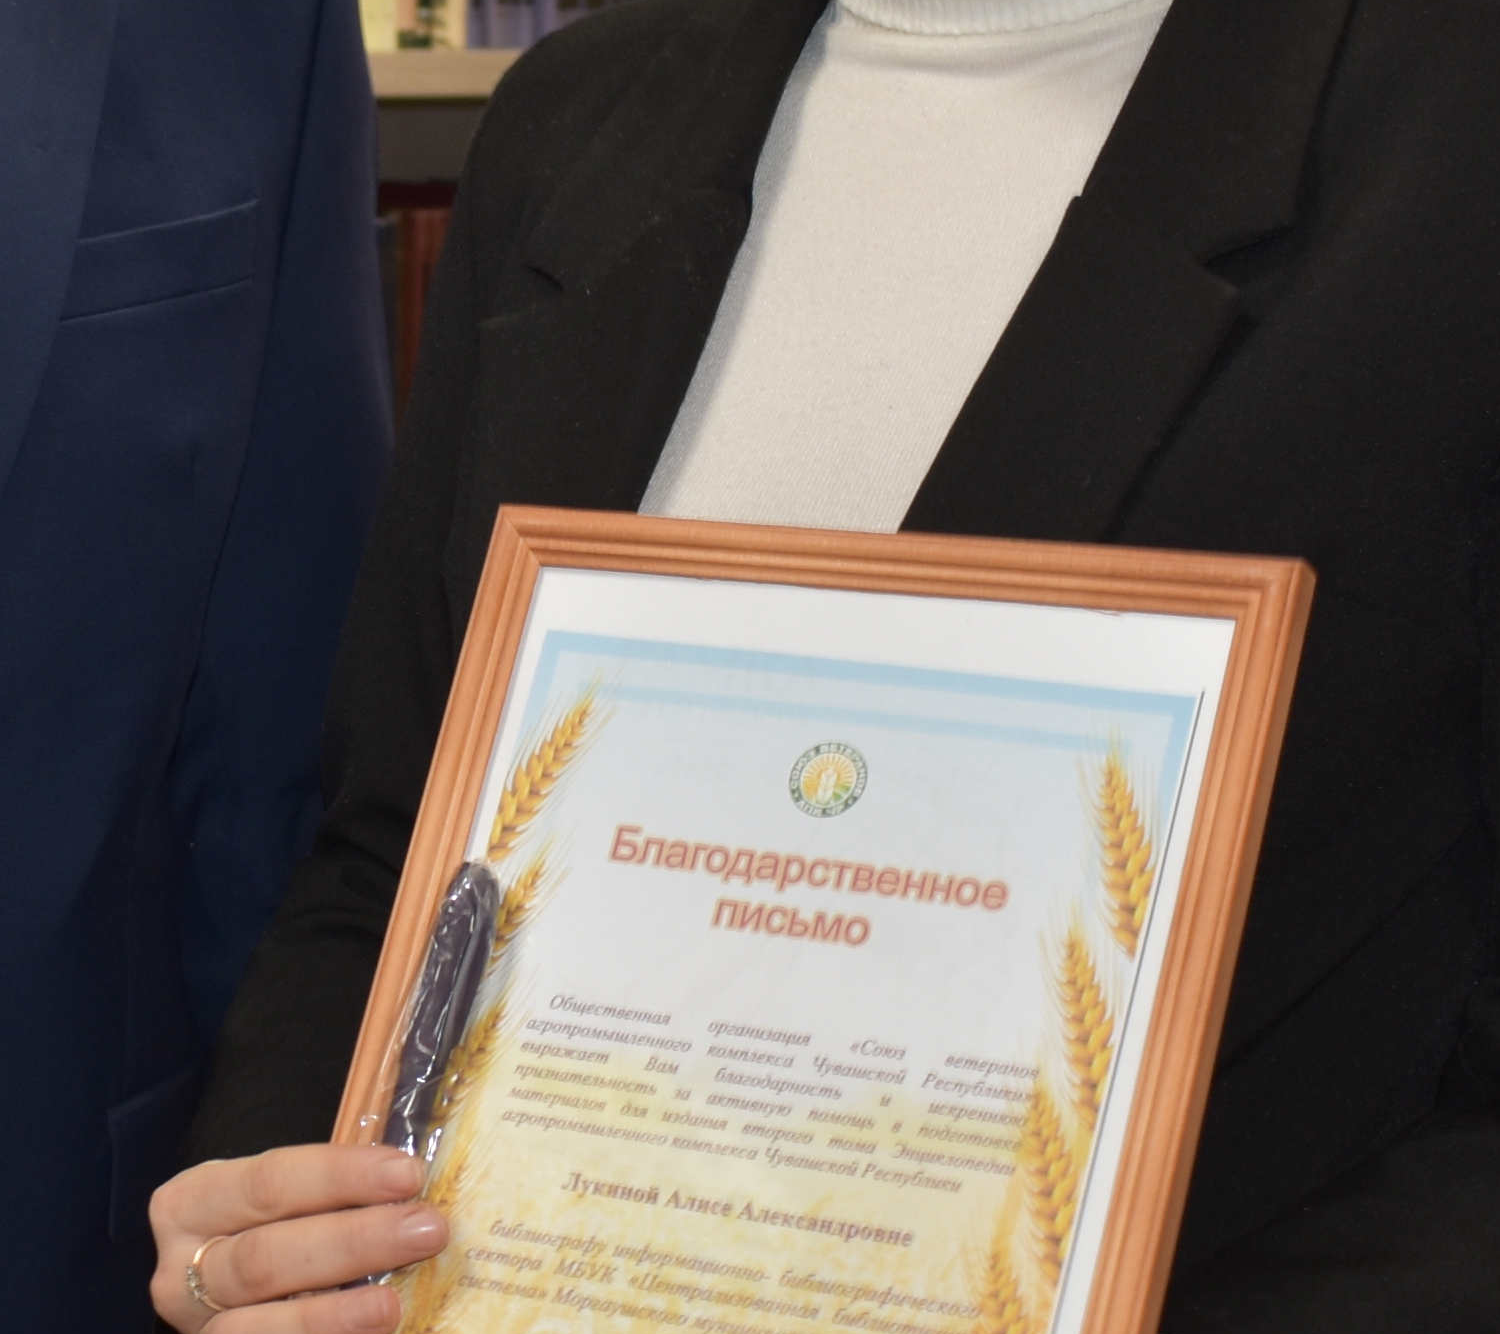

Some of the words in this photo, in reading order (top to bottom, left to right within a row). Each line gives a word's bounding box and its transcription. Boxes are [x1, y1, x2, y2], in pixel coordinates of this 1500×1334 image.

[608, 824, 1009, 911] Благодарственное
[711, 898, 872, 947] письмо
[520, 1040, 610, 1065] выражает
[643, 1055, 680, 1075] Вам
[714, 1067, 843, 1100] благодарность
[878, 1093, 893, 1108] и
[526, 1018, 693, 1053] агропромышленного
[706, 1044, 794, 1068] комплекса
[813, 1055, 906, 1085] Чувашской
[549, 994, 672, 1026] Общественная
[707, 1020, 812, 1047] организация
[850, 1038, 906, 1061] «Союз
[944, 1054, 1040, 1080] ветеранов
[506, 1087, 607, 1113] материалов
[619, 1102, 648, 1119] для
[661, 1109, 729, 1132] издания
[741, 1122, 813, 1145] второго
[827, 1135, 877, 1155] тома
[890, 1142, 1016, 1177] Энциклопедии
[513, 1063, 657, 1096] признательность
[672, 1087, 692, 1102] за
[706, 1092, 793, 1118] активную
[807, 1108, 875, 1131] помощь
[890, 1120, 903, 1134] в
[916, 1125, 1023, 1153] подготовке
[501, 1109, 668, 1146] агропромышленного
[670, 1135, 759, 1161] комплекса
[764, 1147, 858, 1177] Чувашской
[860, 1162, 962, 1194] Республики
[561, 1172, 660, 1205] Лукиной
[665, 1189, 732, 1218] Алисе
[737, 1200, 914, 1248] Александровне
[458, 1273, 547, 1301] система»
[551, 1287, 689, 1328] Моргаушского
[465, 1246, 543, 1273] сектора
[553, 1259, 617, 1285] МБУК
[627, 1273, 820, 1321] «Централизованная
[488, 1220, 607, 1259] библиографу
[778, 1270, 982, 1320] библиографического
